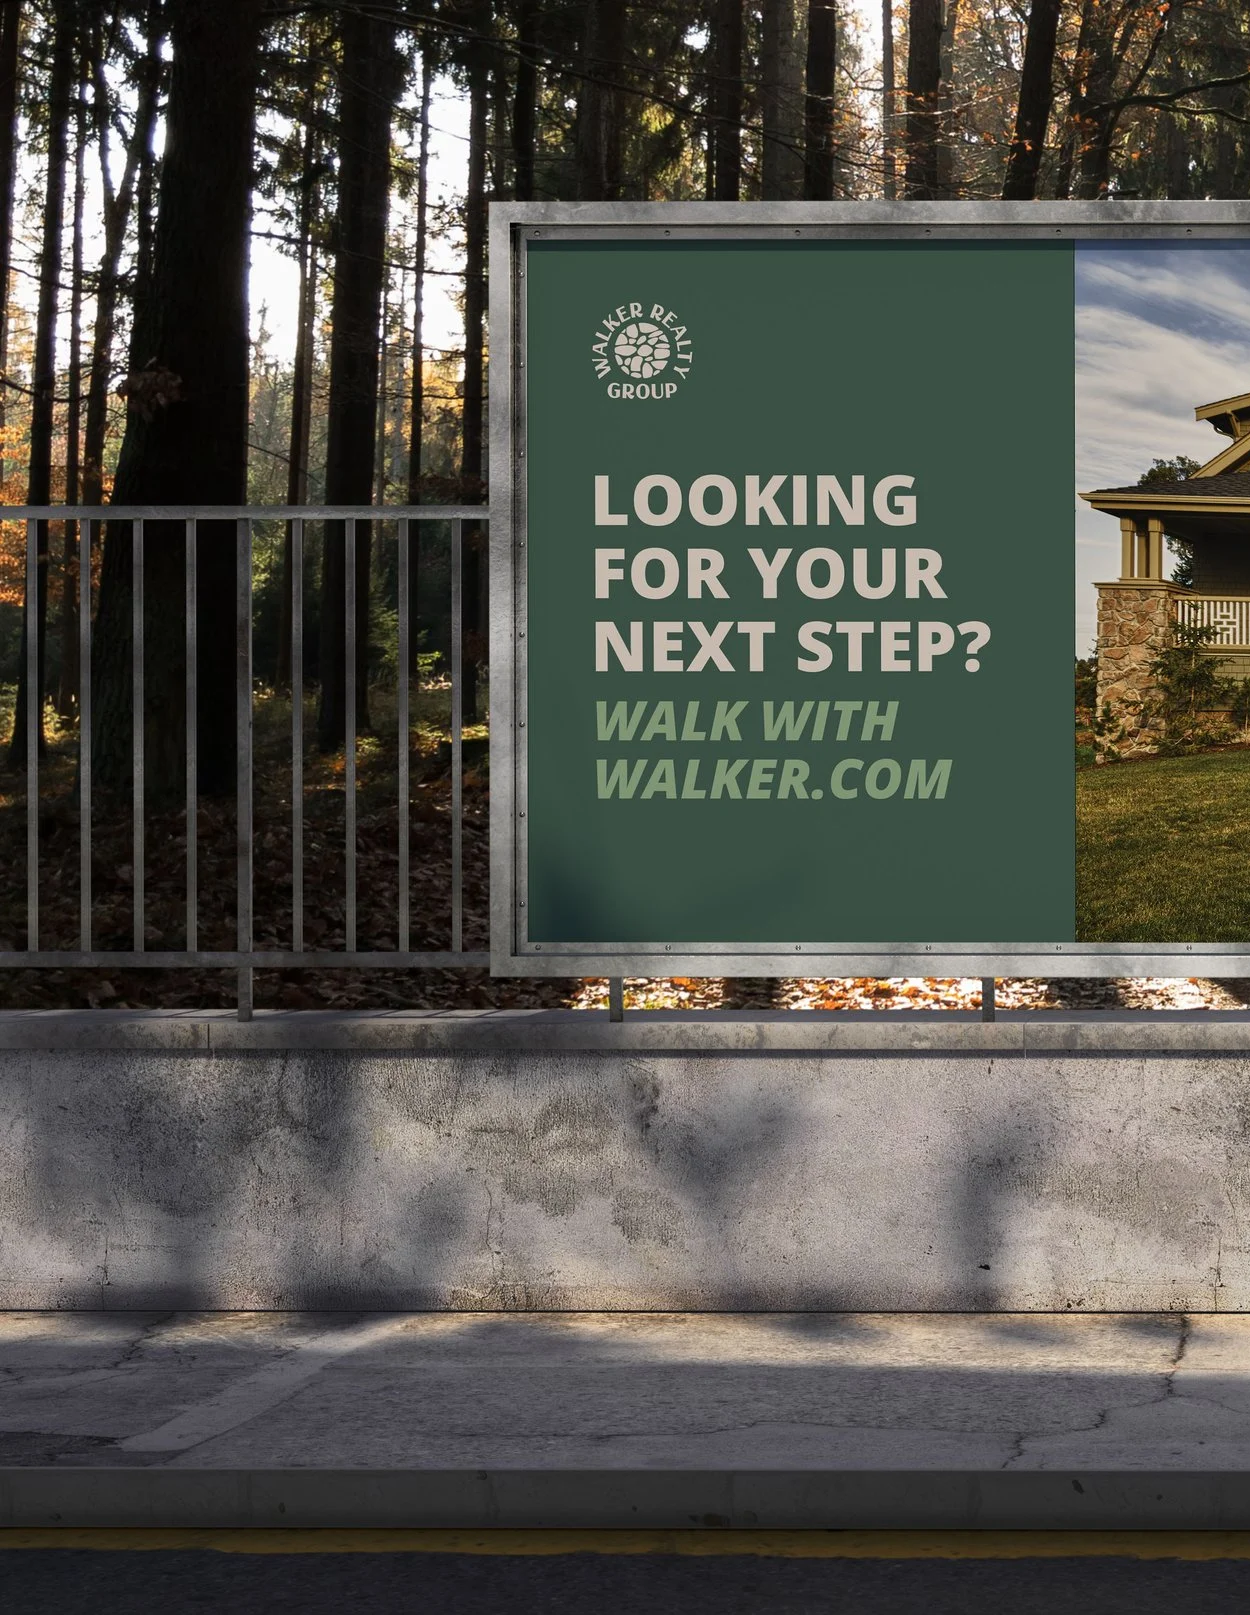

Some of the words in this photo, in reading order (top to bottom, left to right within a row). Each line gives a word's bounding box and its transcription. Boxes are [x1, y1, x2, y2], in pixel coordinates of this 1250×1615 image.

[592, 302, 643, 379] WALKER
[650, 303, 693, 379] REALTY
[607, 383, 677, 399] GROUP
[595, 474, 916, 526] LOOKING
[595, 547, 730, 599] FOR
[747, 547, 948, 599] YOUR
[595, 621, 775, 672] NEXT
[798, 621, 991, 672] STEP?
[596, 701, 749, 741] WALK
[763, 701, 899, 741] WITH
[597, 759, 952, 799] WALKER.COM
